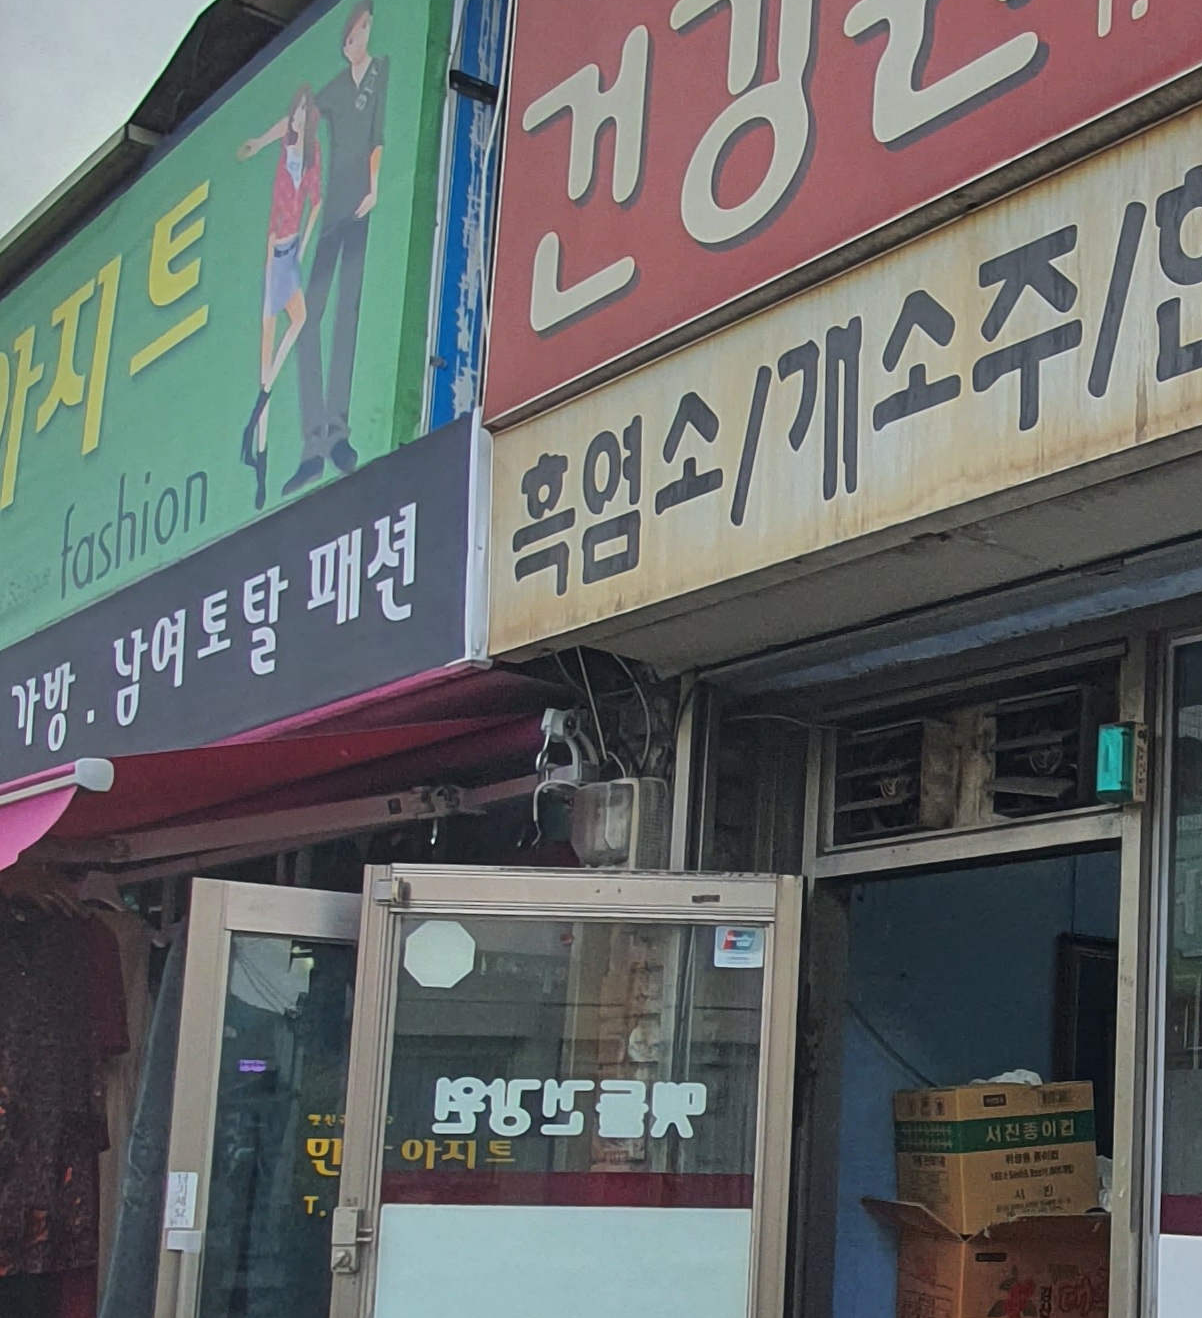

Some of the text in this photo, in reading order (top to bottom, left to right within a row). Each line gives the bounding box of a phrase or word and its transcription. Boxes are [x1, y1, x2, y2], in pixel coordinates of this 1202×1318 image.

[60, 471, 208, 600] fashion
[113, 565, 289, 728] 남여토탈
[306, 501, 418, 625] 패션
